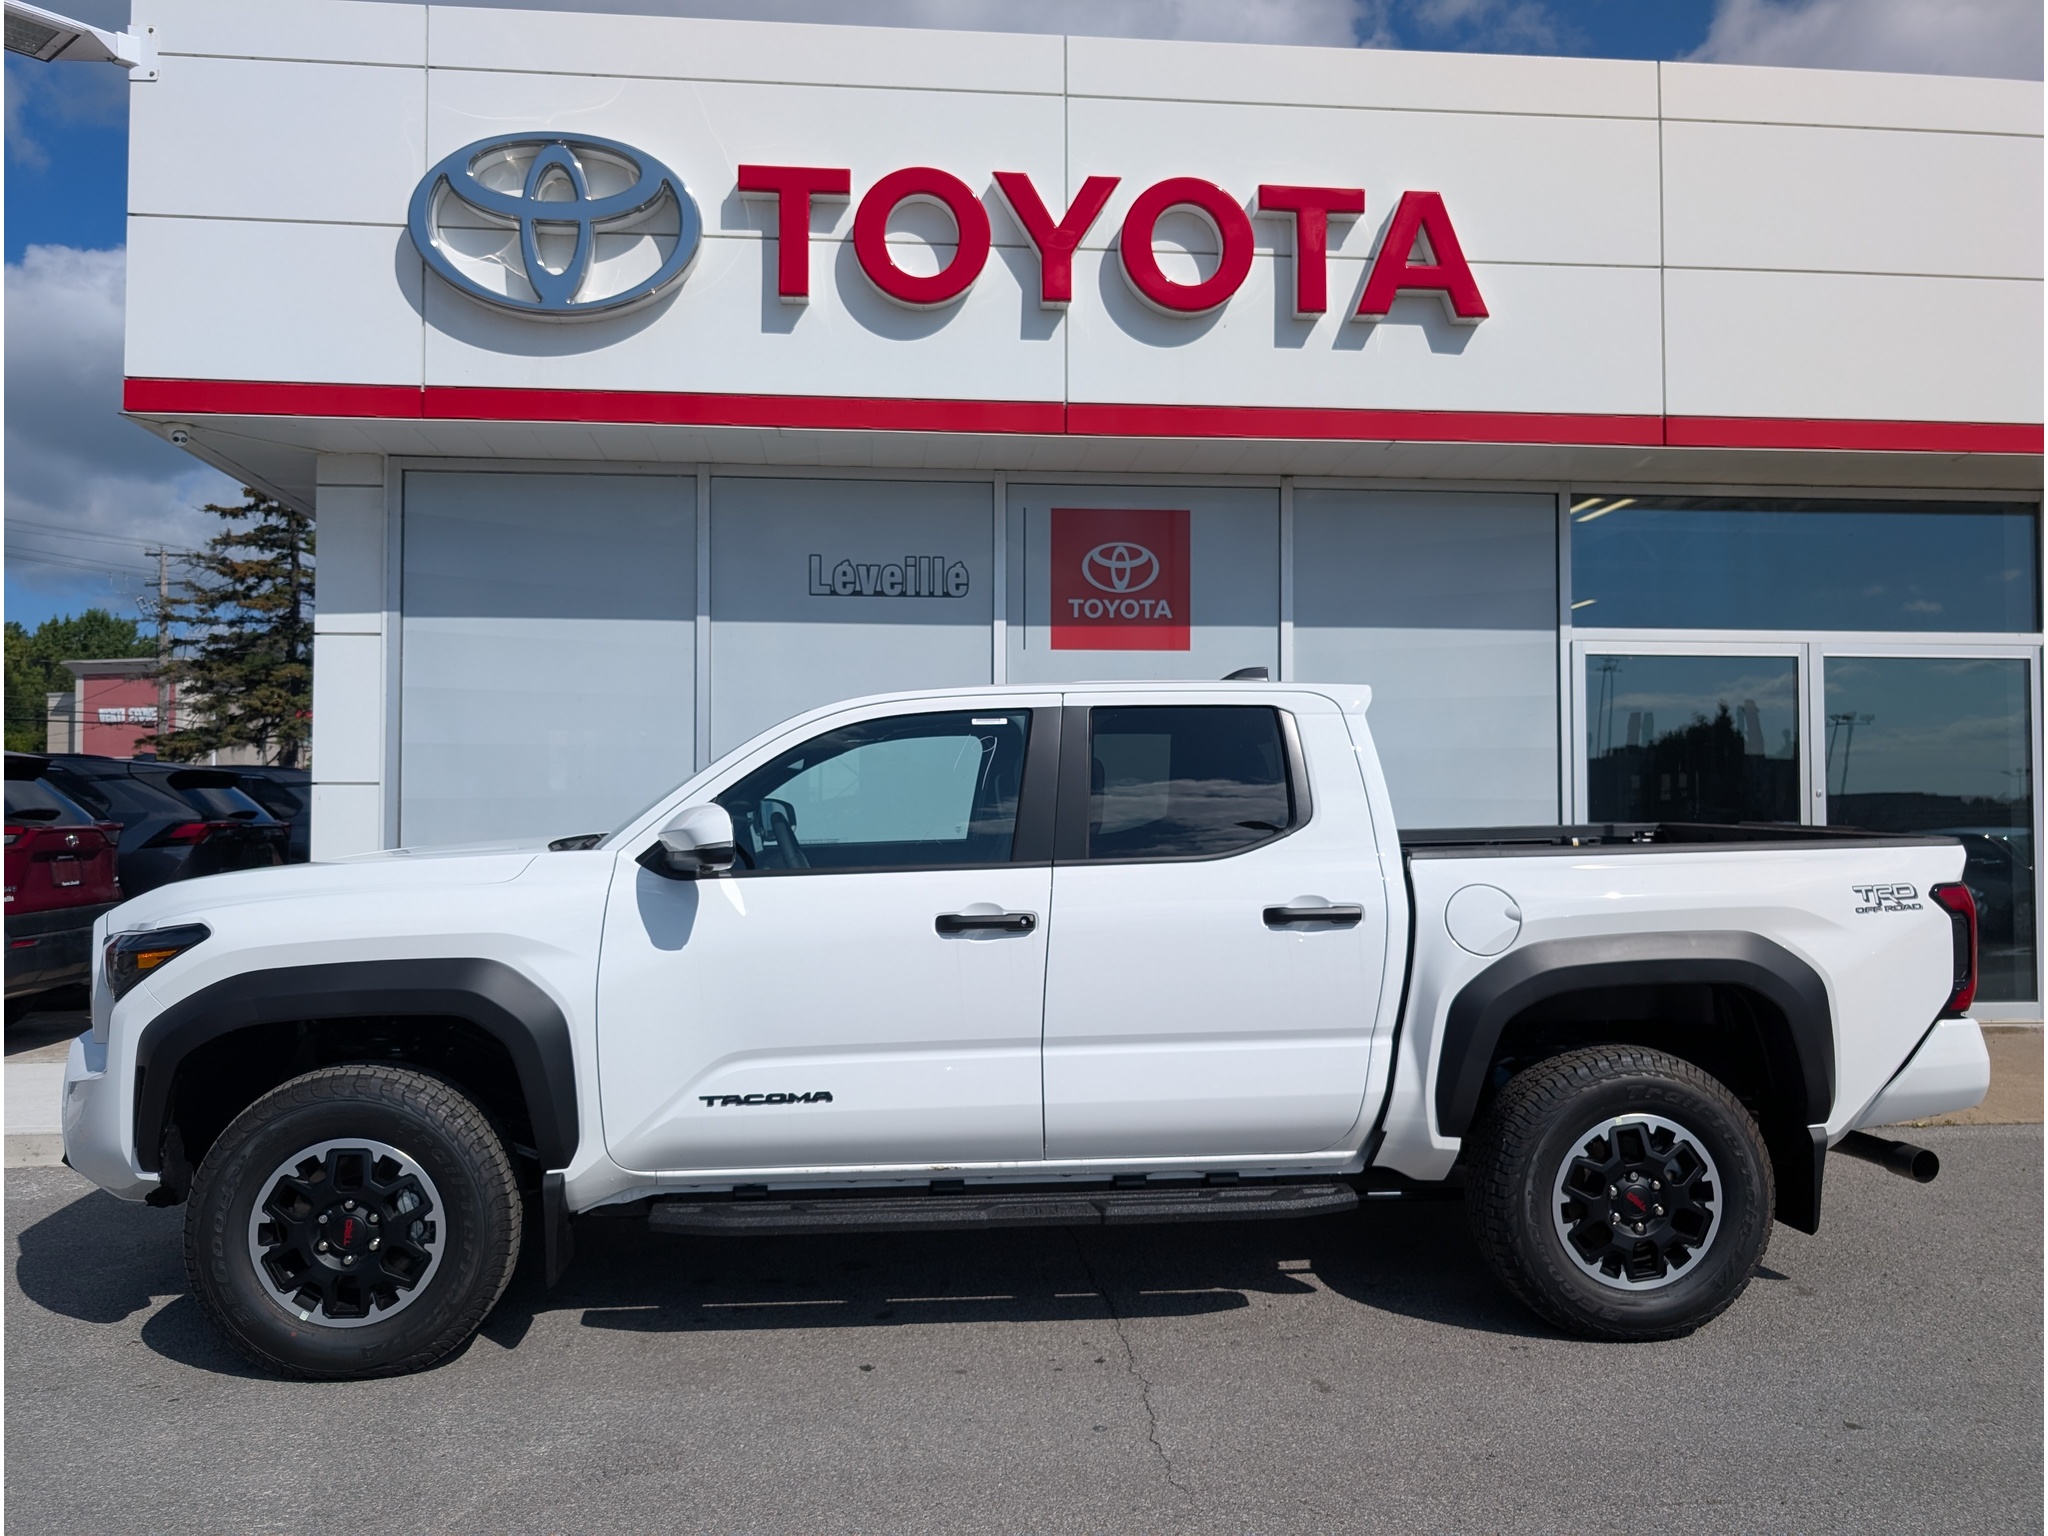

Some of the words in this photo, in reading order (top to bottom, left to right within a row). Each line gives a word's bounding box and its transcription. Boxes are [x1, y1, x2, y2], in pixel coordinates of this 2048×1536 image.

[737, 164, 1489, 322] TOYOTA
[808, 553, 970, 599] Léveillé
[1067, 598, 1173, 619] TOYOTA
[1852, 883, 1918, 905] TRD
[1884, 903, 1922, 912] ROAD
[698, 1091, 833, 1107] TACOMA
[343, 1219, 353, 1246] TRD
